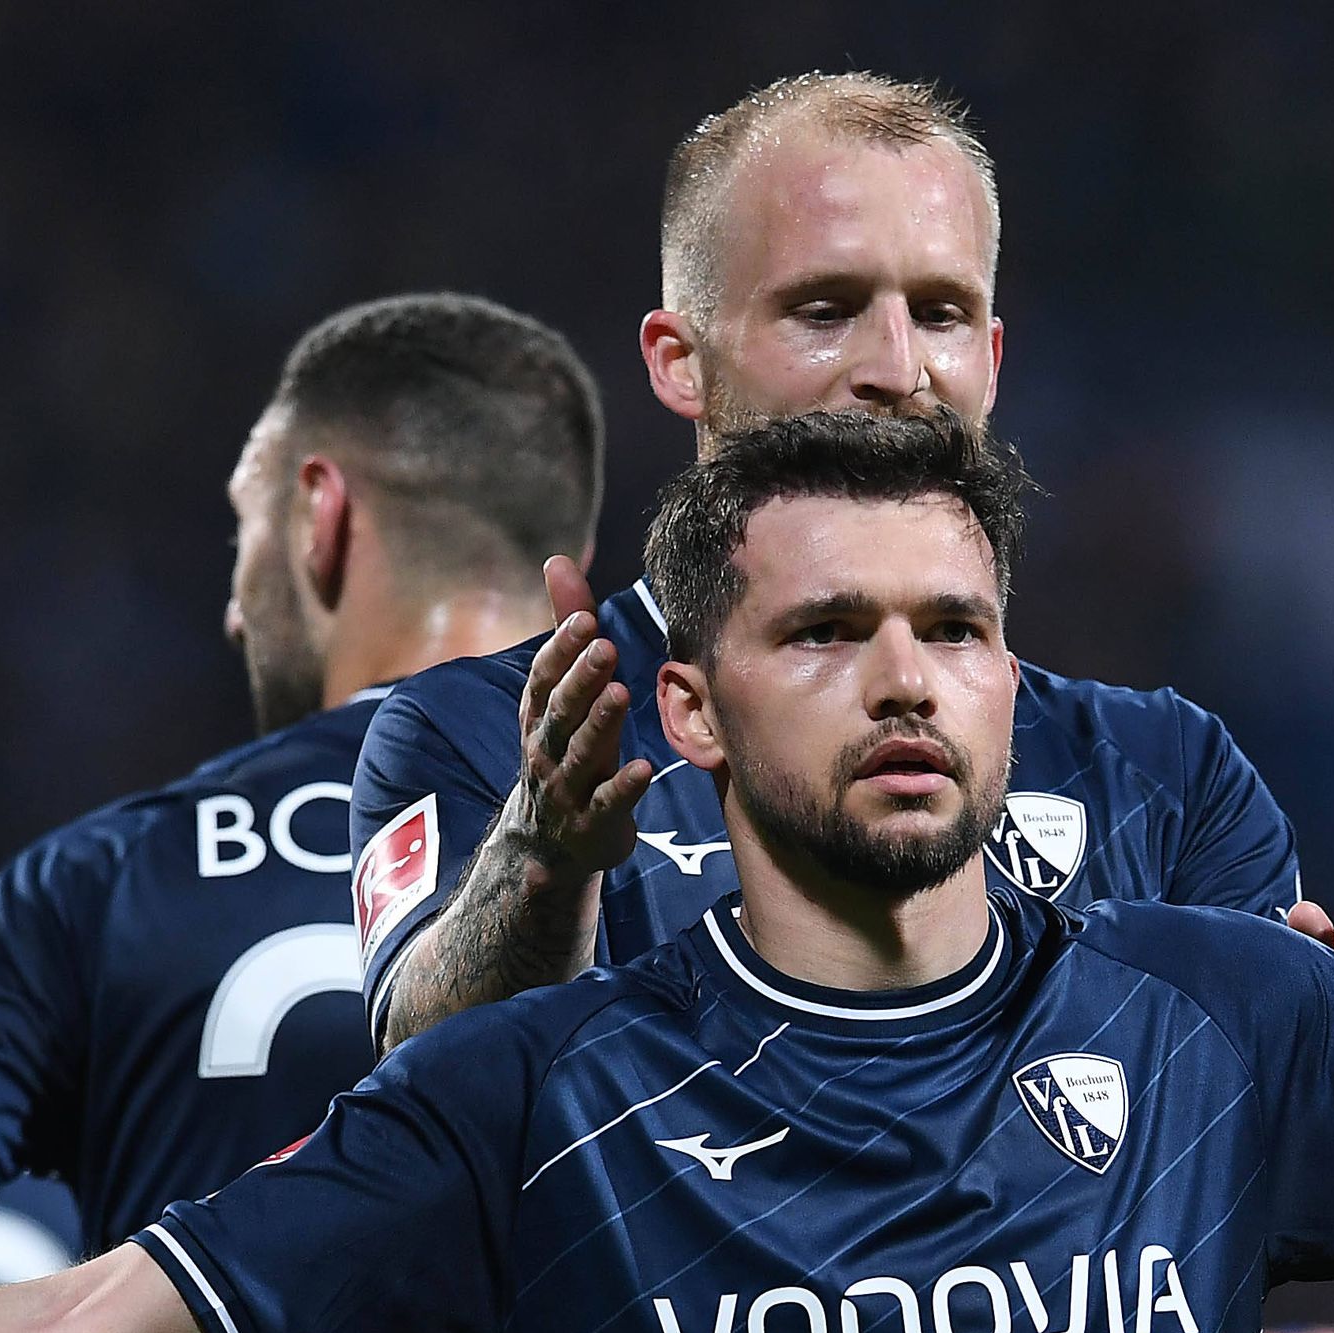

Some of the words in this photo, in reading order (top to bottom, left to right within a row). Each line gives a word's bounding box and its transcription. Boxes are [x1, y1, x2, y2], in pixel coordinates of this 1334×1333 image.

[1023, 812, 1073, 823] Bochum
[1038, 828, 1066, 839] 1848
[1065, 1074, 1114, 1088] Bochum
[1082, 1089, 1109, 1103] 1848
[1020, 1076, 1109, 1159] VfL
